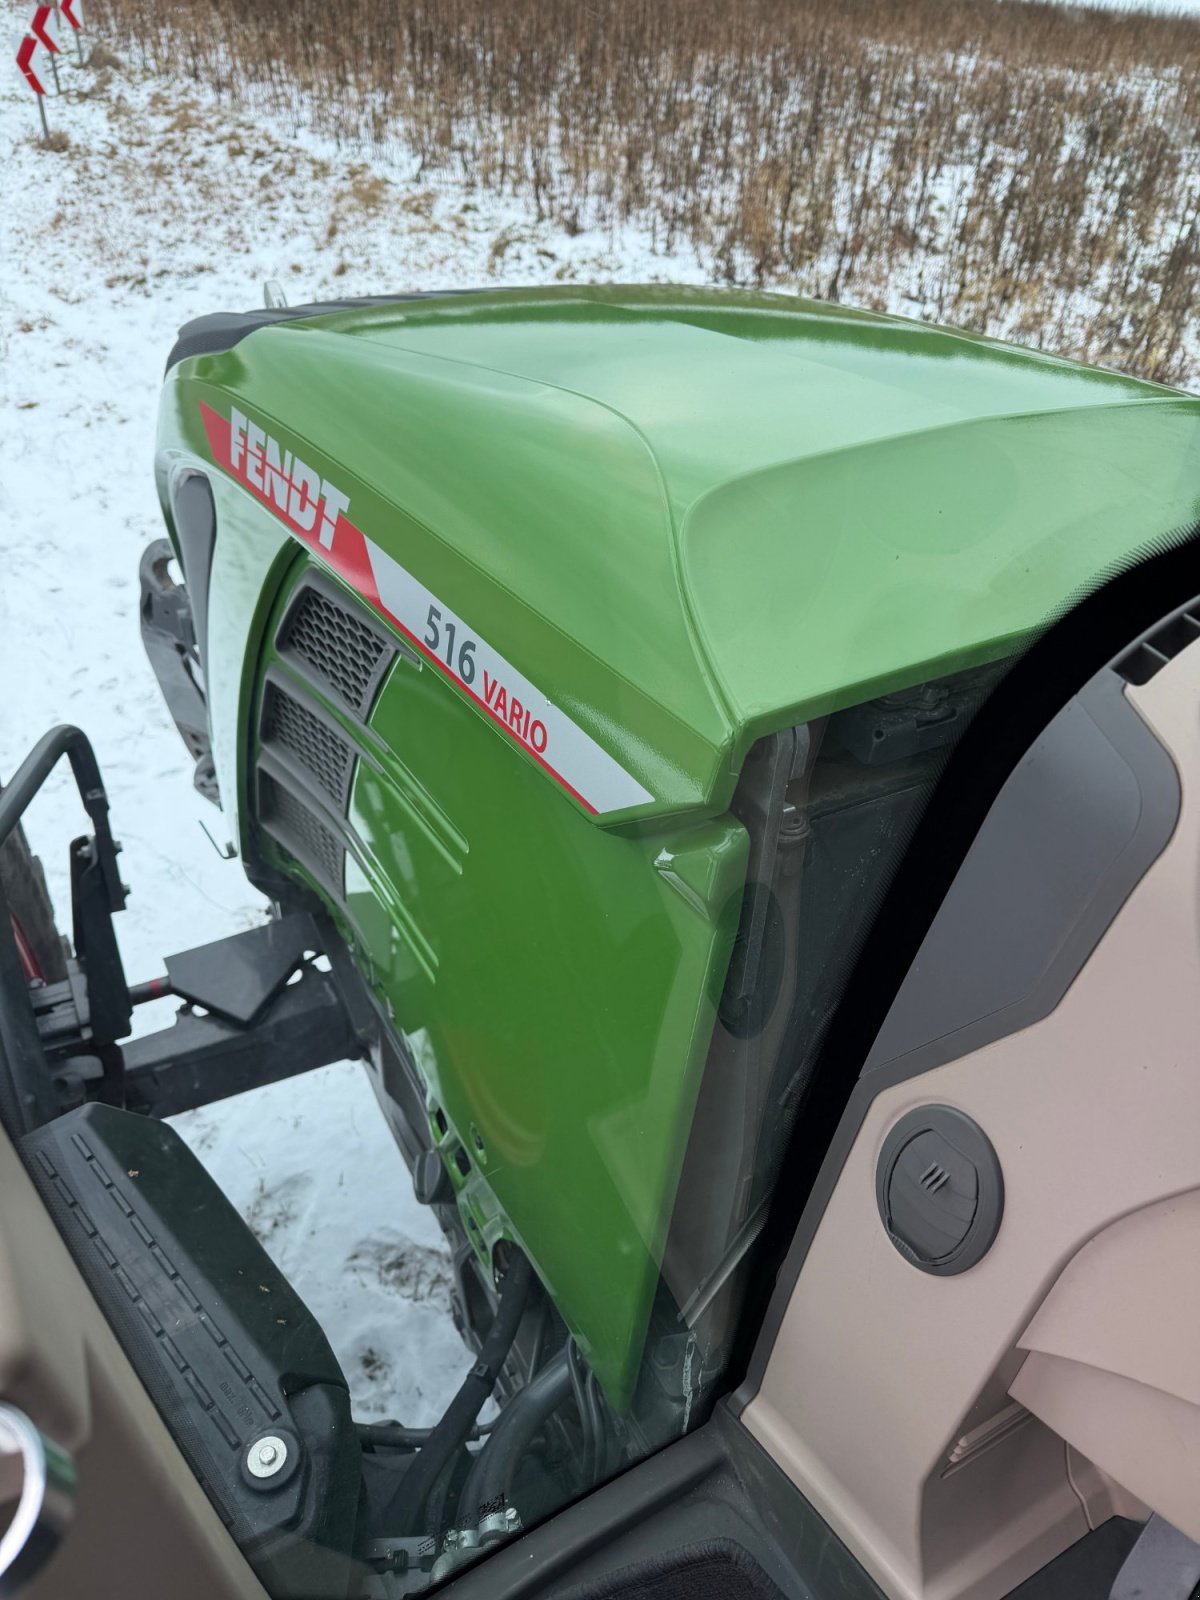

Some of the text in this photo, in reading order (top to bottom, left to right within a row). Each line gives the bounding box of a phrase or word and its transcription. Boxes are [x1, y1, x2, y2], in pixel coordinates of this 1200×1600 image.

[231, 405, 350, 552] FENDT
[424, 604, 547, 753] 516 VARIO
